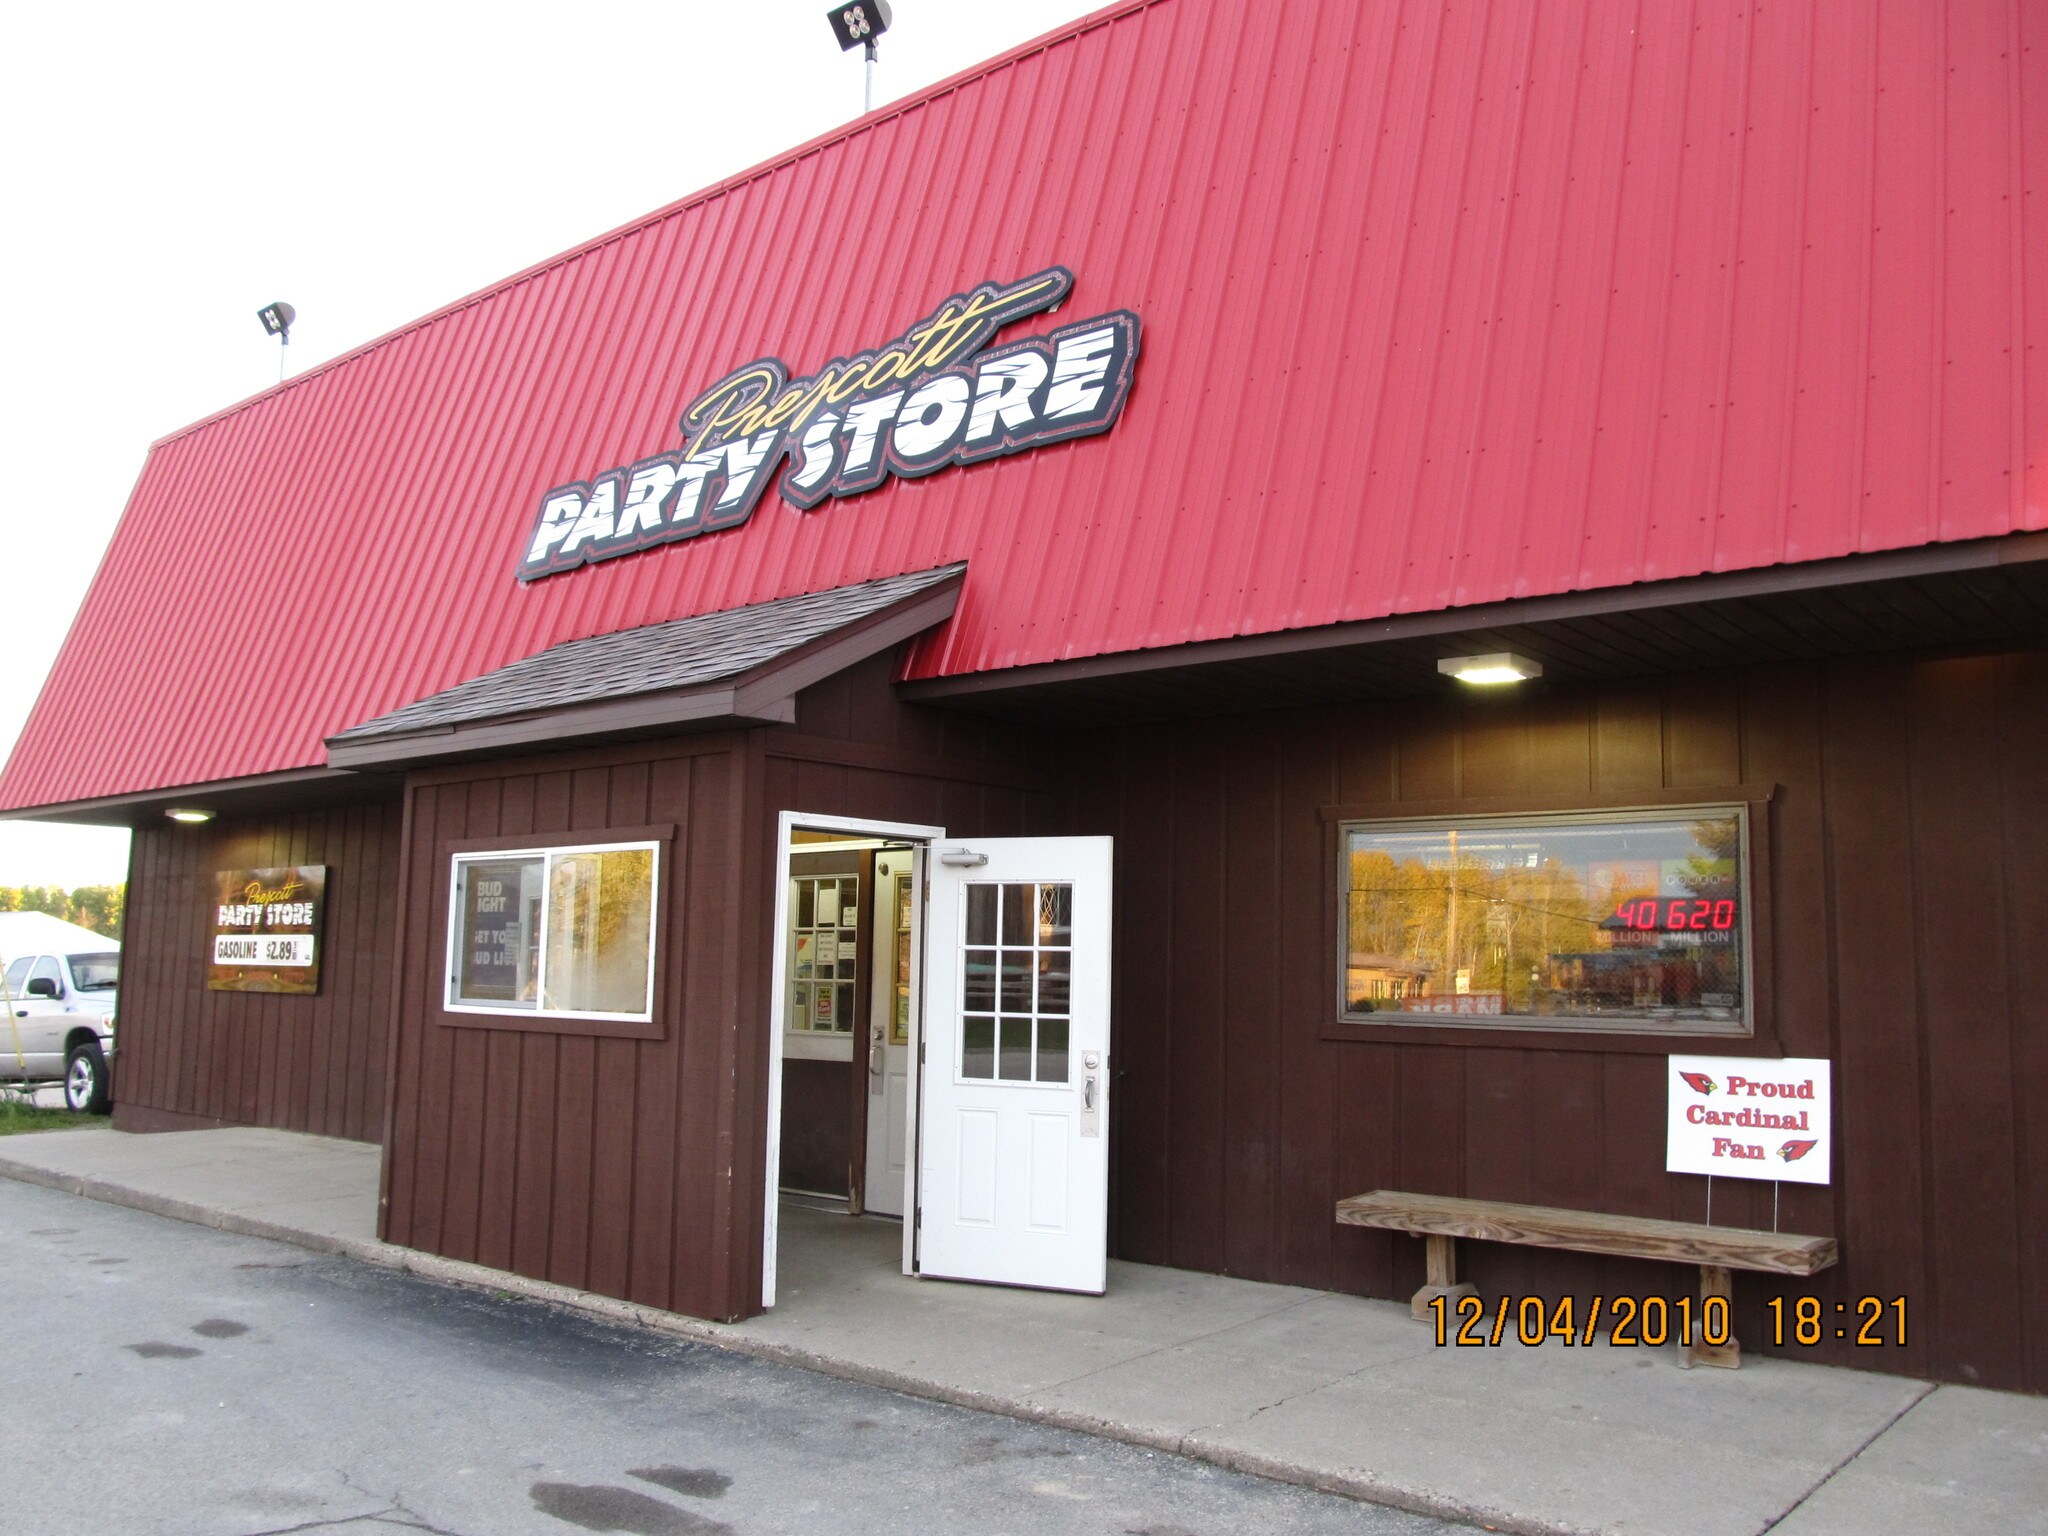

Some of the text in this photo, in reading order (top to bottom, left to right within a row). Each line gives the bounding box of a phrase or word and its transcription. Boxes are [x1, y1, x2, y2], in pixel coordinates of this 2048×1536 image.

[687, 280, 1052, 462] Prescott
[526, 326, 1115, 564] PARTY STORE
[245, 882, 304, 905] Prescott
[478, 881, 502, 896] BUD
[218, 902, 313, 926] PARTY STORE
[1616, 899, 1735, 930] 40 620
[1596, 931, 1729, 943] MILLION MILLION
[218, 941, 257, 959] GASOLINE
[266, 941, 292, 960] $2.89
[1727, 1076, 1815, 1100] Proud
[1686, 1105, 1809, 1131] Cardinal
[1712, 1137, 1766, 1160] Fan
